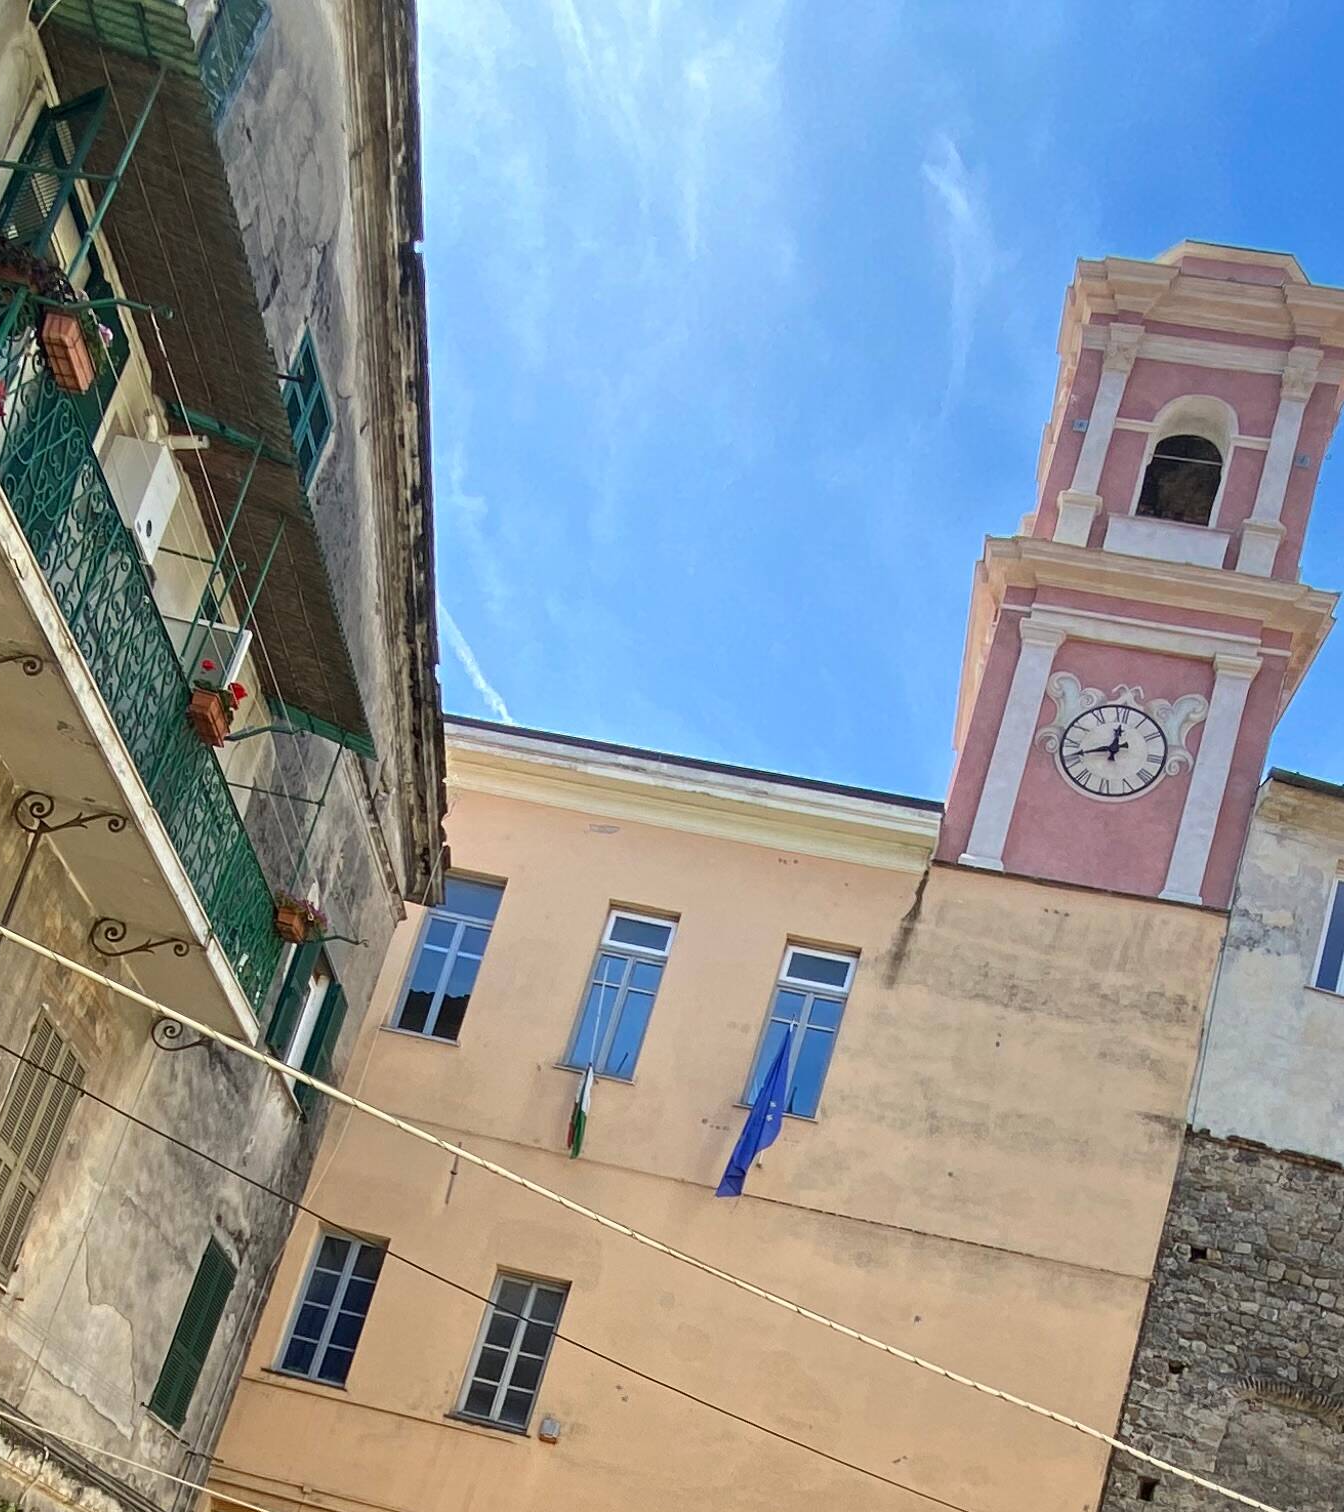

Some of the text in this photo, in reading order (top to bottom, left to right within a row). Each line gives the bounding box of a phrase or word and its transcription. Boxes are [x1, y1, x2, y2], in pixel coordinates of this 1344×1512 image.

[1135, 716, 1148, 729] I
[1143, 732, 1161, 742] II
[1146, 753, 1162, 764] III
